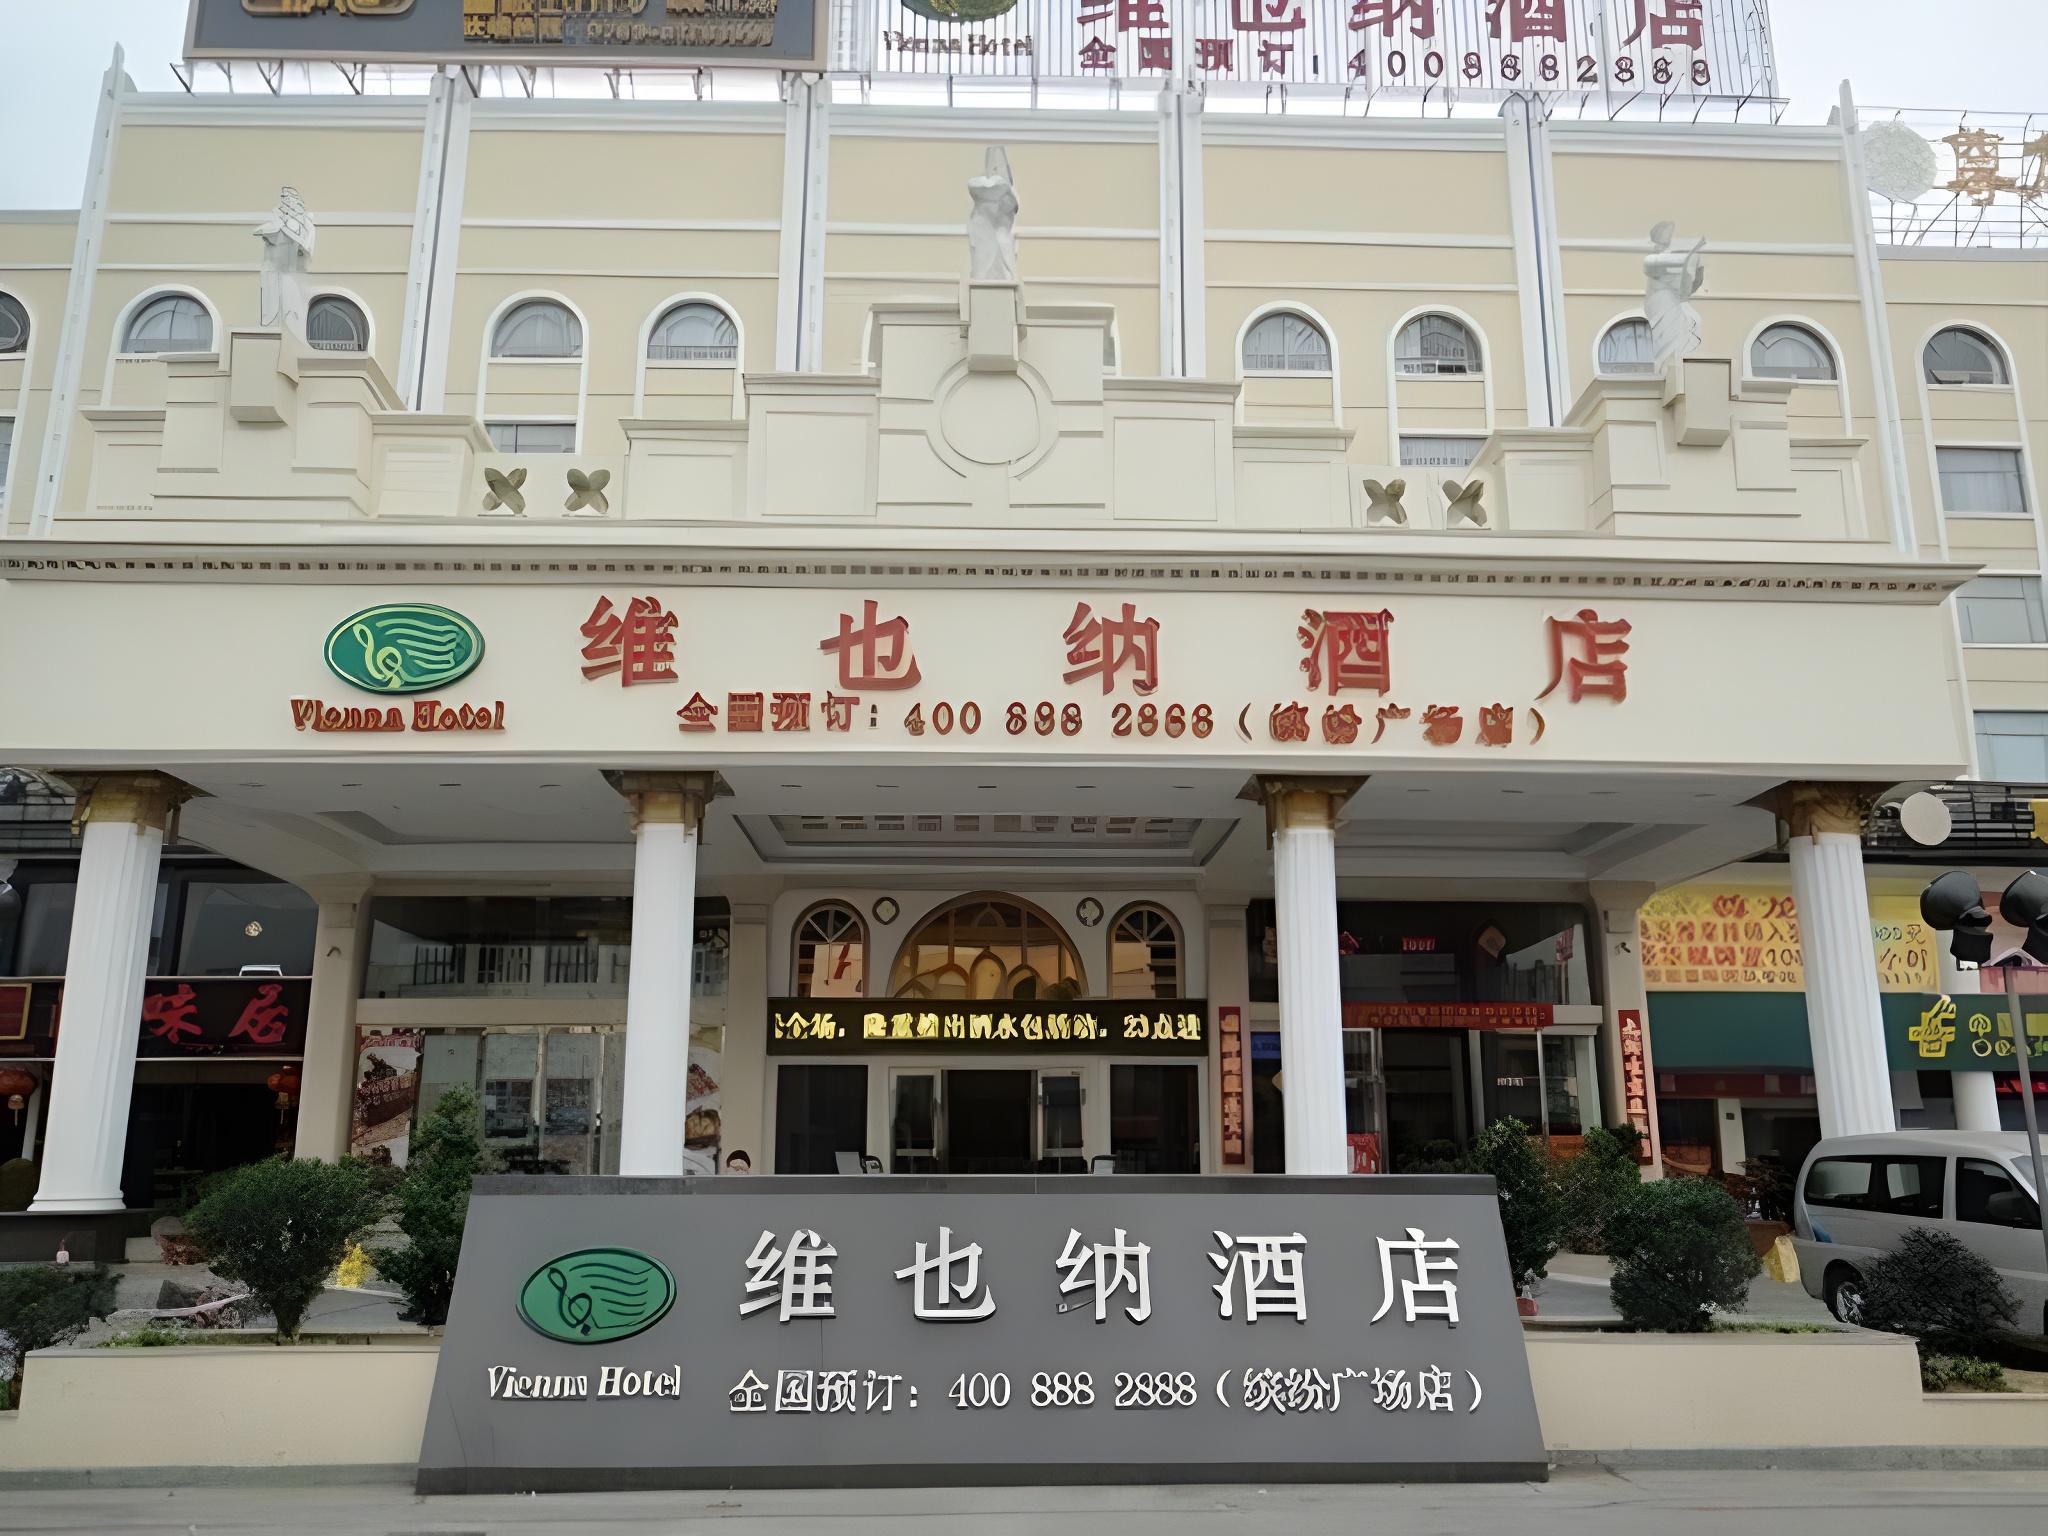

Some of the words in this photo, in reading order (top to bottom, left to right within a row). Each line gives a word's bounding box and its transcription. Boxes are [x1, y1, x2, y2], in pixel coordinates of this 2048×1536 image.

[579, 596, 1632, 703] 维也纳酒店
[740, 1226, 1461, 1326] 维也纳酒店
[597, 1364, 681, 1398] Hotel
[948, 1372, 1011, 1409] 400
[1031, 1371, 1095, 1408] 888
[1114, 1371, 1198, 1408] 2888
